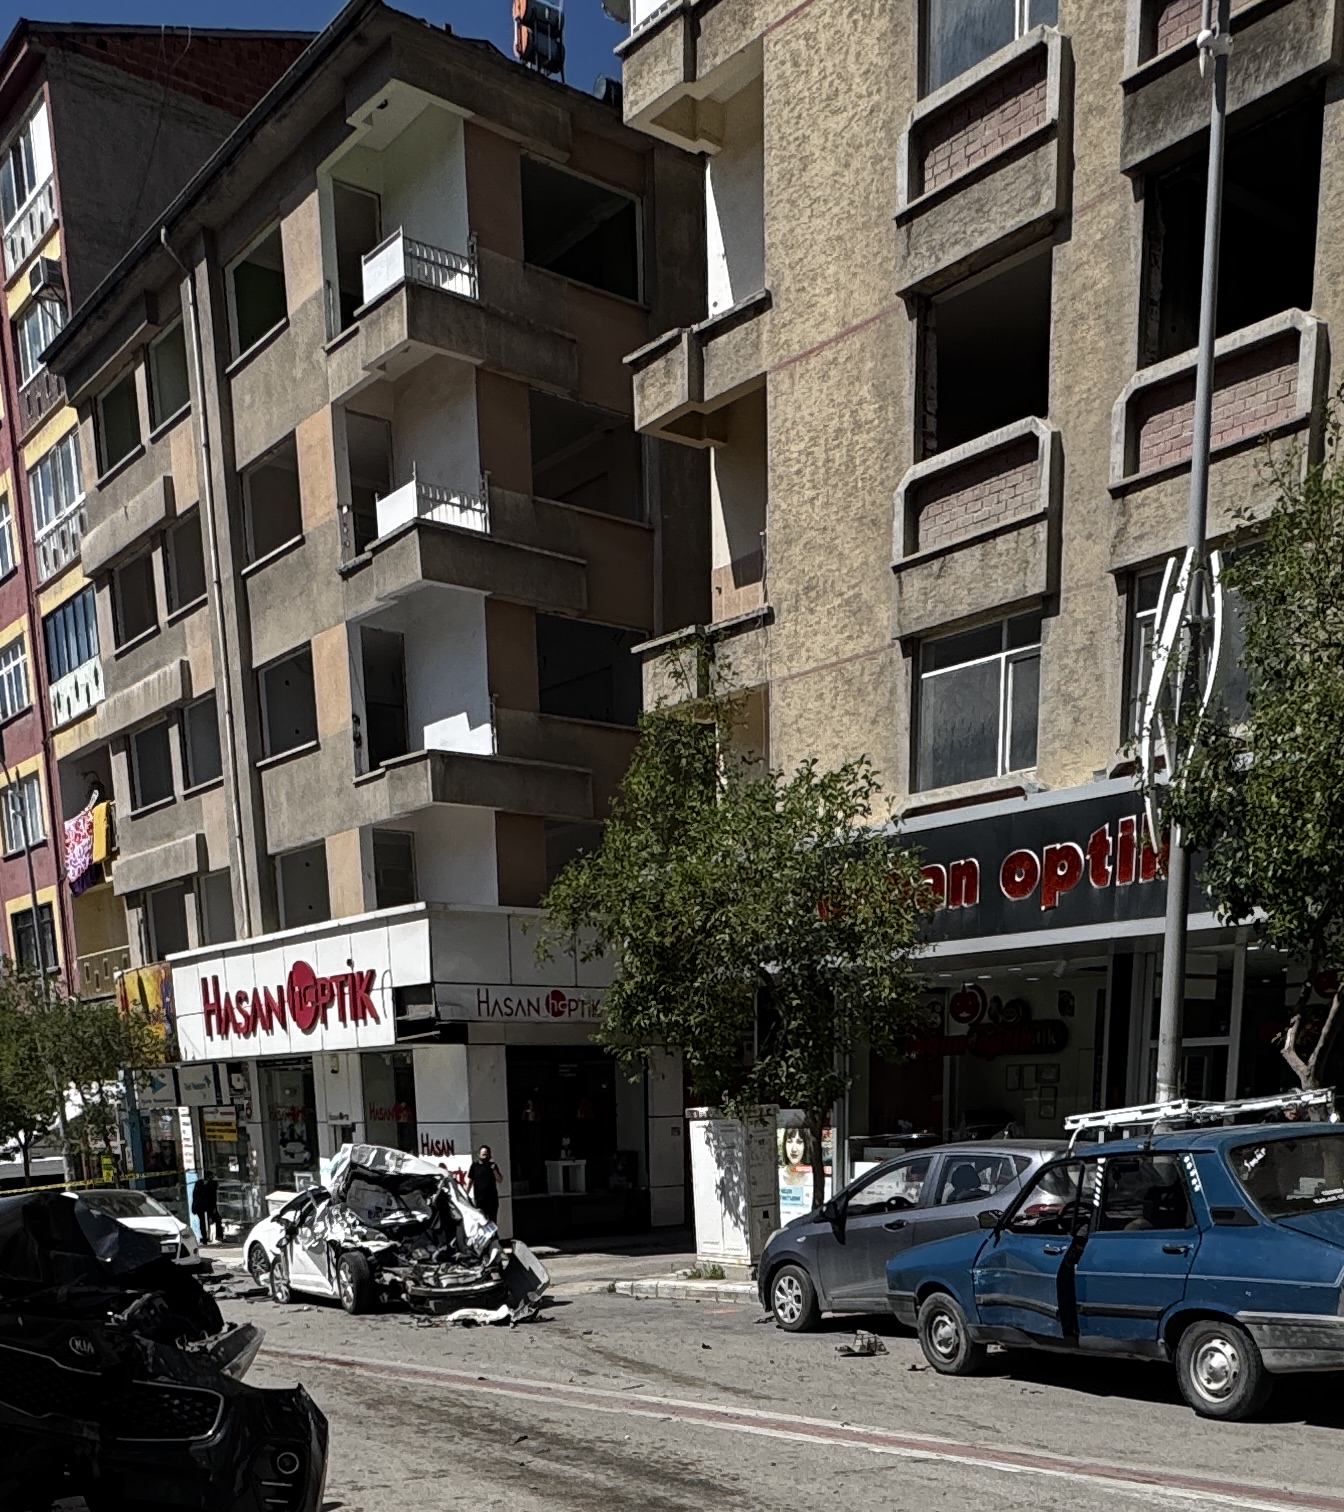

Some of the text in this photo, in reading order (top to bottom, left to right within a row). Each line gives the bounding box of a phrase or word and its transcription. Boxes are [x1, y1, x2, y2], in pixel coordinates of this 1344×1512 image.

[201, 974, 289, 1038] HASAN
[476, 988, 541, 1017] HASAN
[420, 1132, 455, 1157] HASAN
[72, 1338, 95, 1354] KIA
